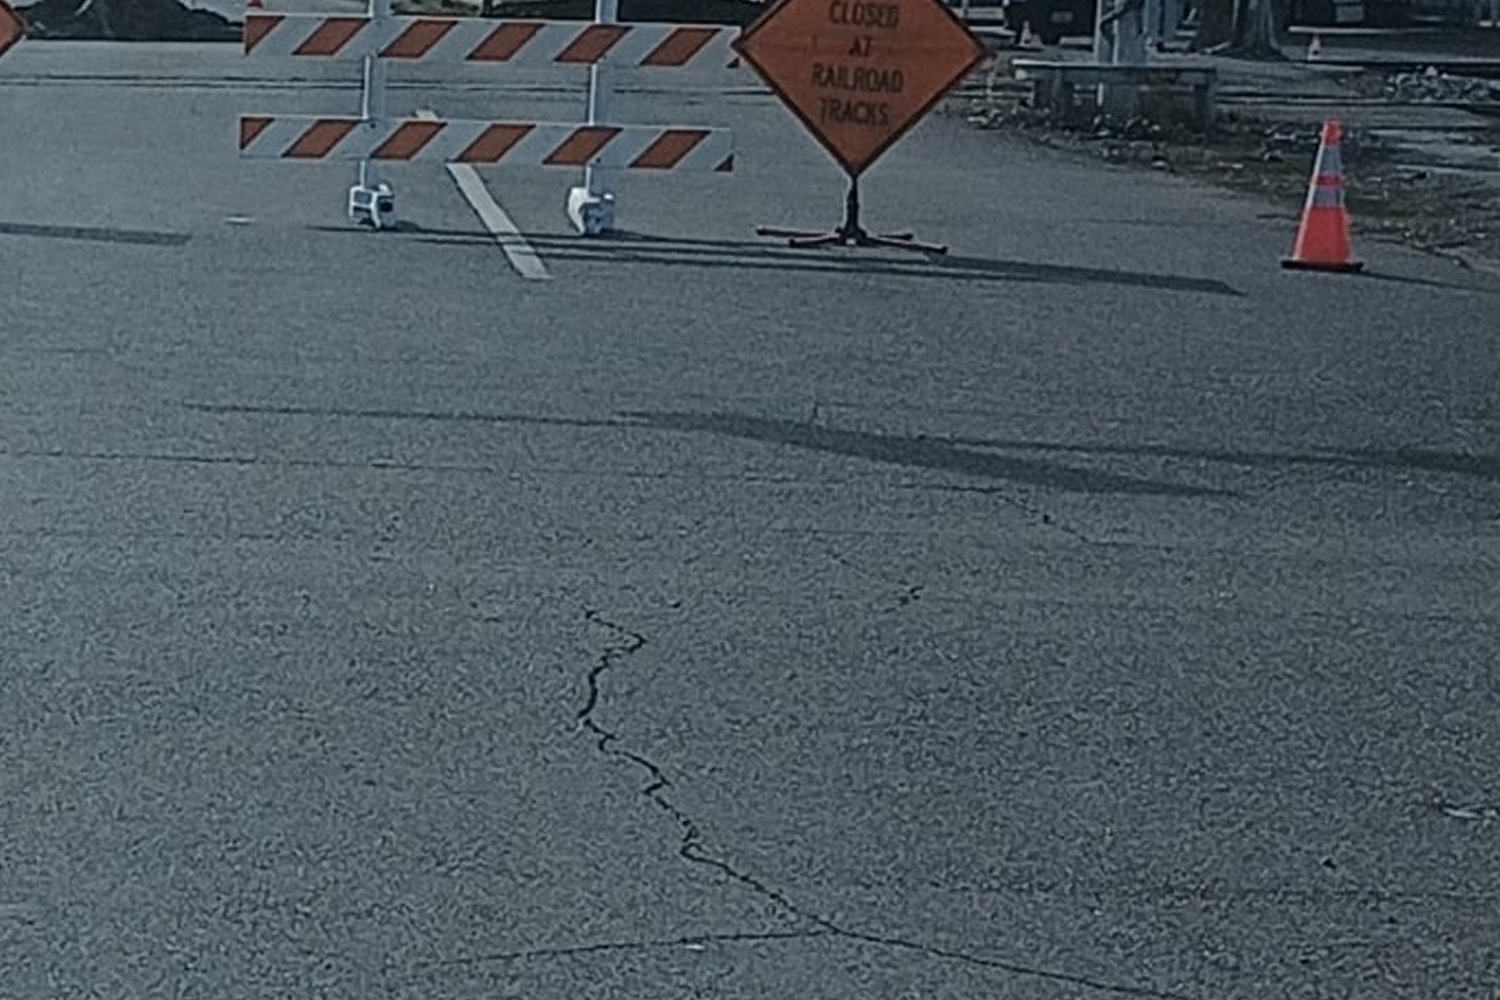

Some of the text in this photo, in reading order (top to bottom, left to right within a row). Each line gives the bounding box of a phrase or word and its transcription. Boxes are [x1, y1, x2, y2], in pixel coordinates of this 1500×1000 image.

[828, 0, 899, 28] CLOSED
[849, 35, 872, 57] AT
[811, 62, 904, 93] RAILROAD
[820, 98, 889, 126] TRACKS
